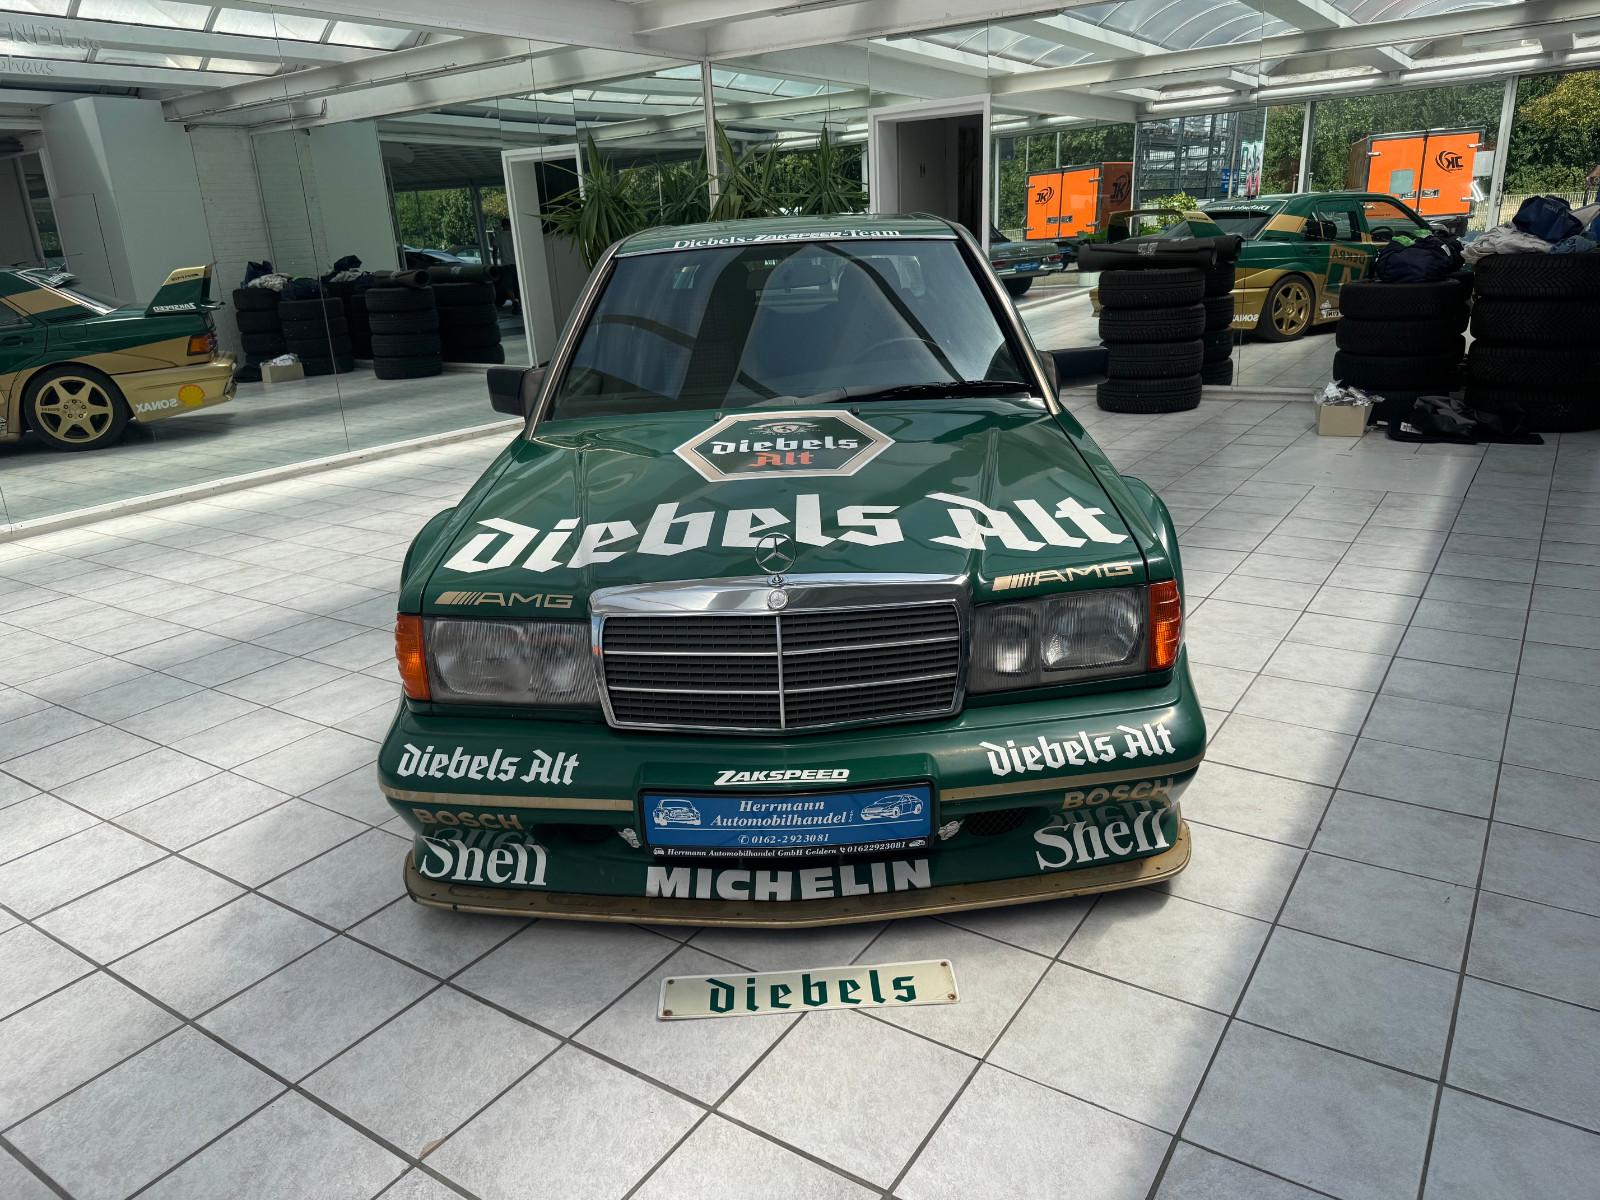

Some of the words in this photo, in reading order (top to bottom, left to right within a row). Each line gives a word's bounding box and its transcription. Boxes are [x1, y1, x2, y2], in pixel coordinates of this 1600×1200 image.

[748, 451, 814, 467] Alt
[925, 492, 1128, 552] Alt
[1116, 721, 1176, 759] Alt
[520, 749, 579, 786] Alt
[714, 768, 850, 785] ZAKSPEED
[739, 799, 825, 812] Herrmann
[1061, 777, 1174, 810] BOSCH
[412, 808, 523, 831] BOSCH
[710, 811, 847, 827] Automobilhandel
[667, 848, 706, 857] Herrmann
[708, 849, 776, 858] Automobilhandel
[777, 848, 803, 857] GmbH
[805, 847, 837, 856] Geldern
[1033, 806, 1170, 871] Shell
[645, 858, 932, 901] MICHELIN
